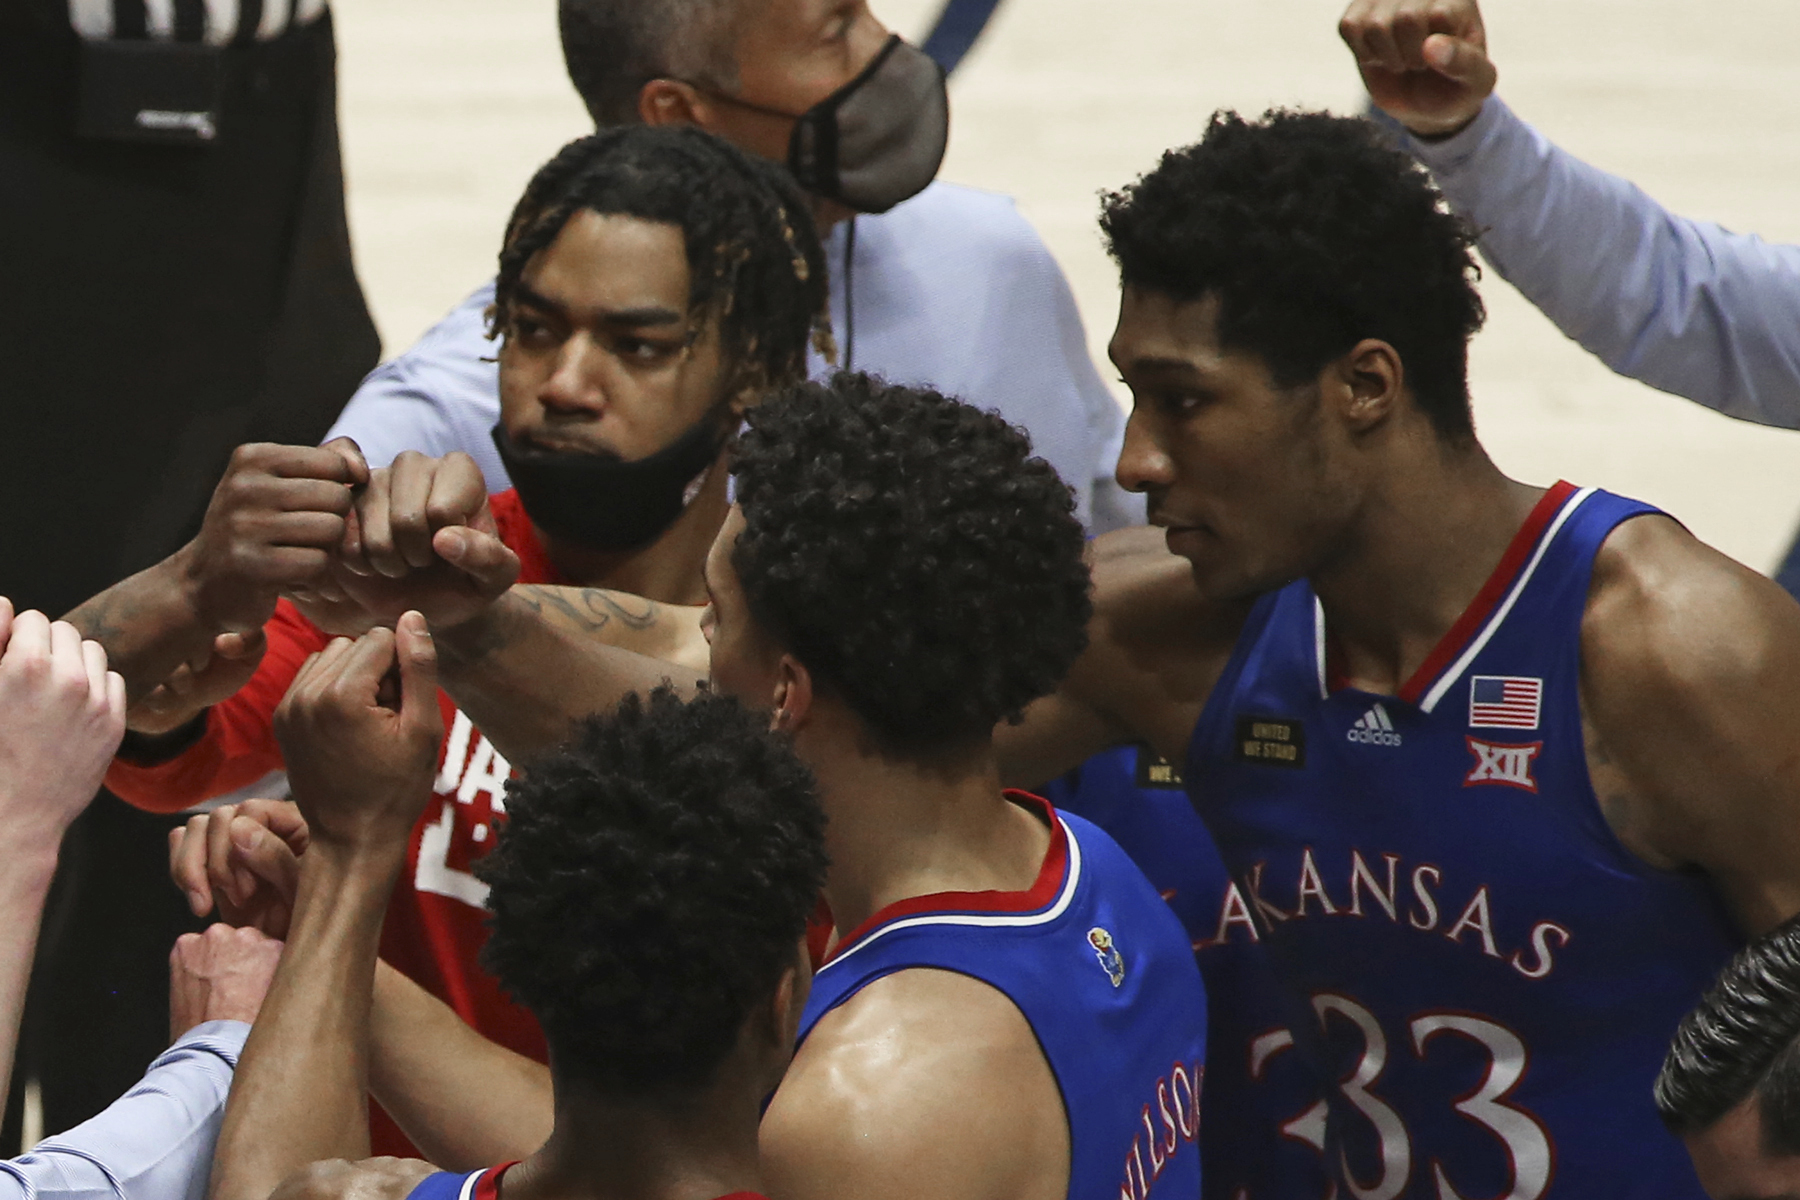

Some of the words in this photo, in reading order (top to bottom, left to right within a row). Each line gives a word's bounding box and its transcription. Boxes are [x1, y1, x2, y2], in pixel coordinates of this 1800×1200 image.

[1347, 728, 1402, 747] adidas
[1465, 736, 1541, 792] XII
[1242, 845, 1571, 979] KANSAS
